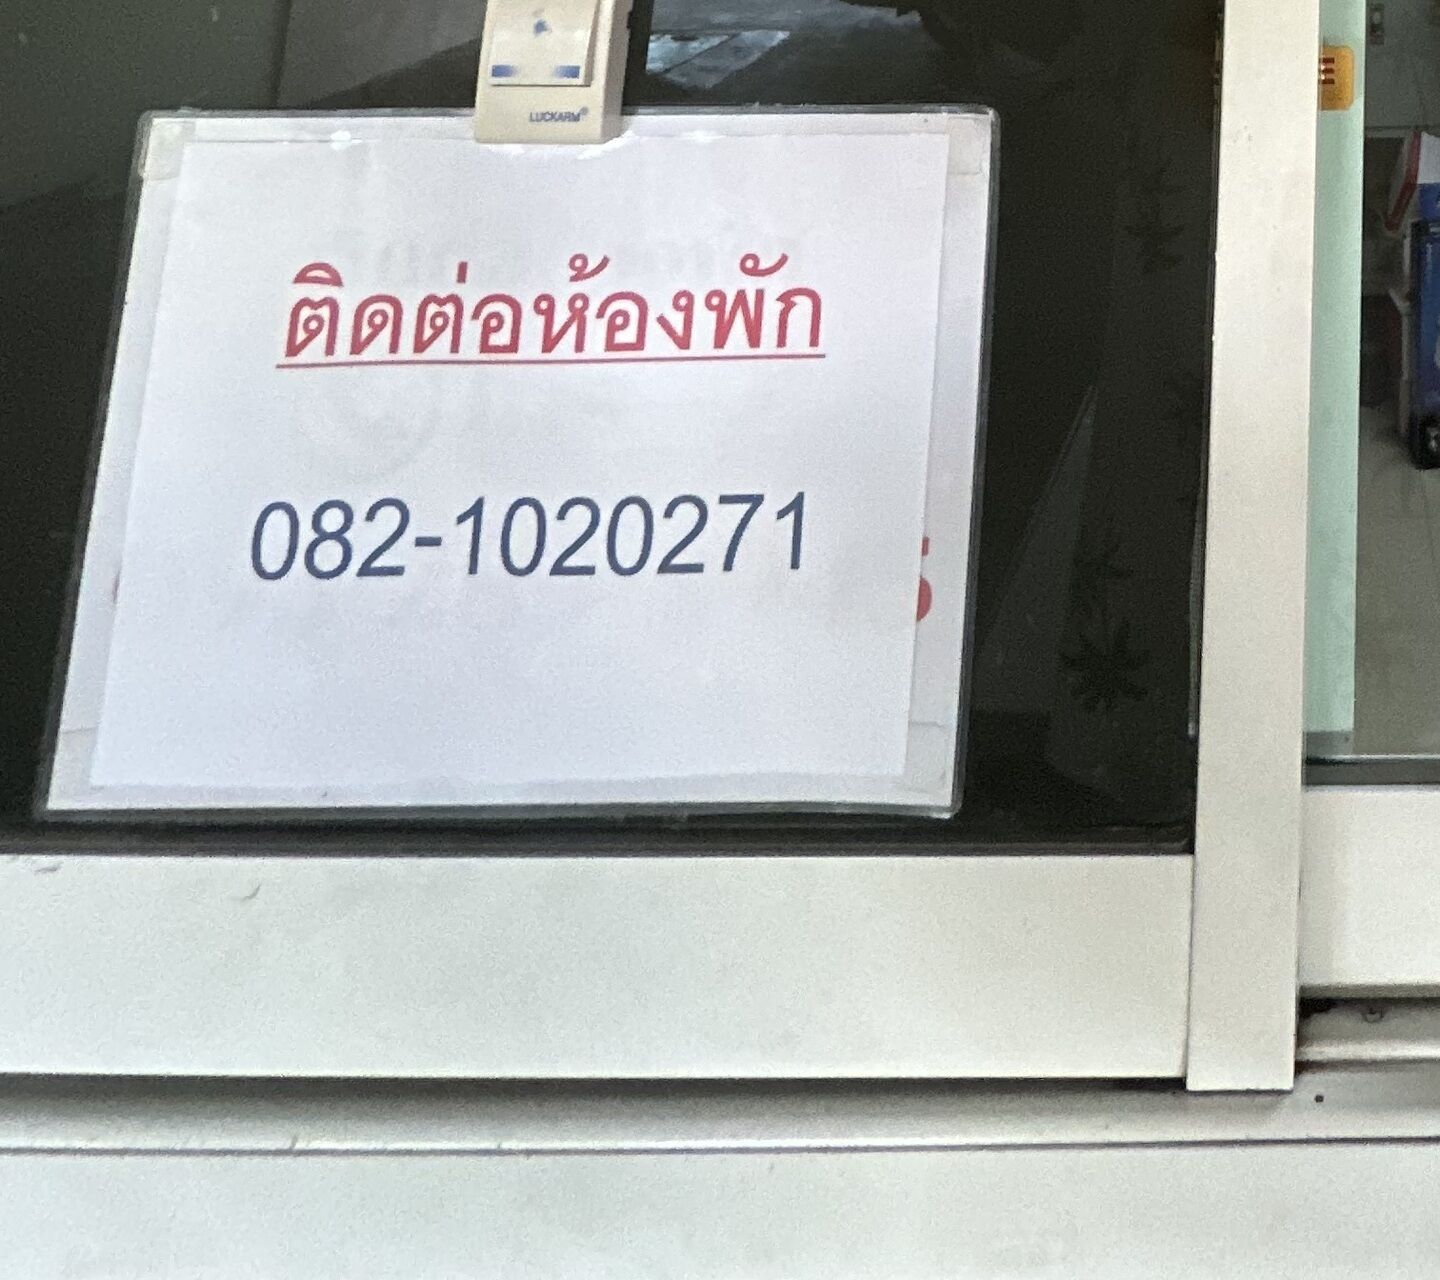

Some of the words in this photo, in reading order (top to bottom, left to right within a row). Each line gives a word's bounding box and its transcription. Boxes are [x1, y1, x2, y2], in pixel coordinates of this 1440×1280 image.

[284, 252, 823, 357] ติดต่อห้องพัก
[250, 491, 806, 581] 082-1020271
